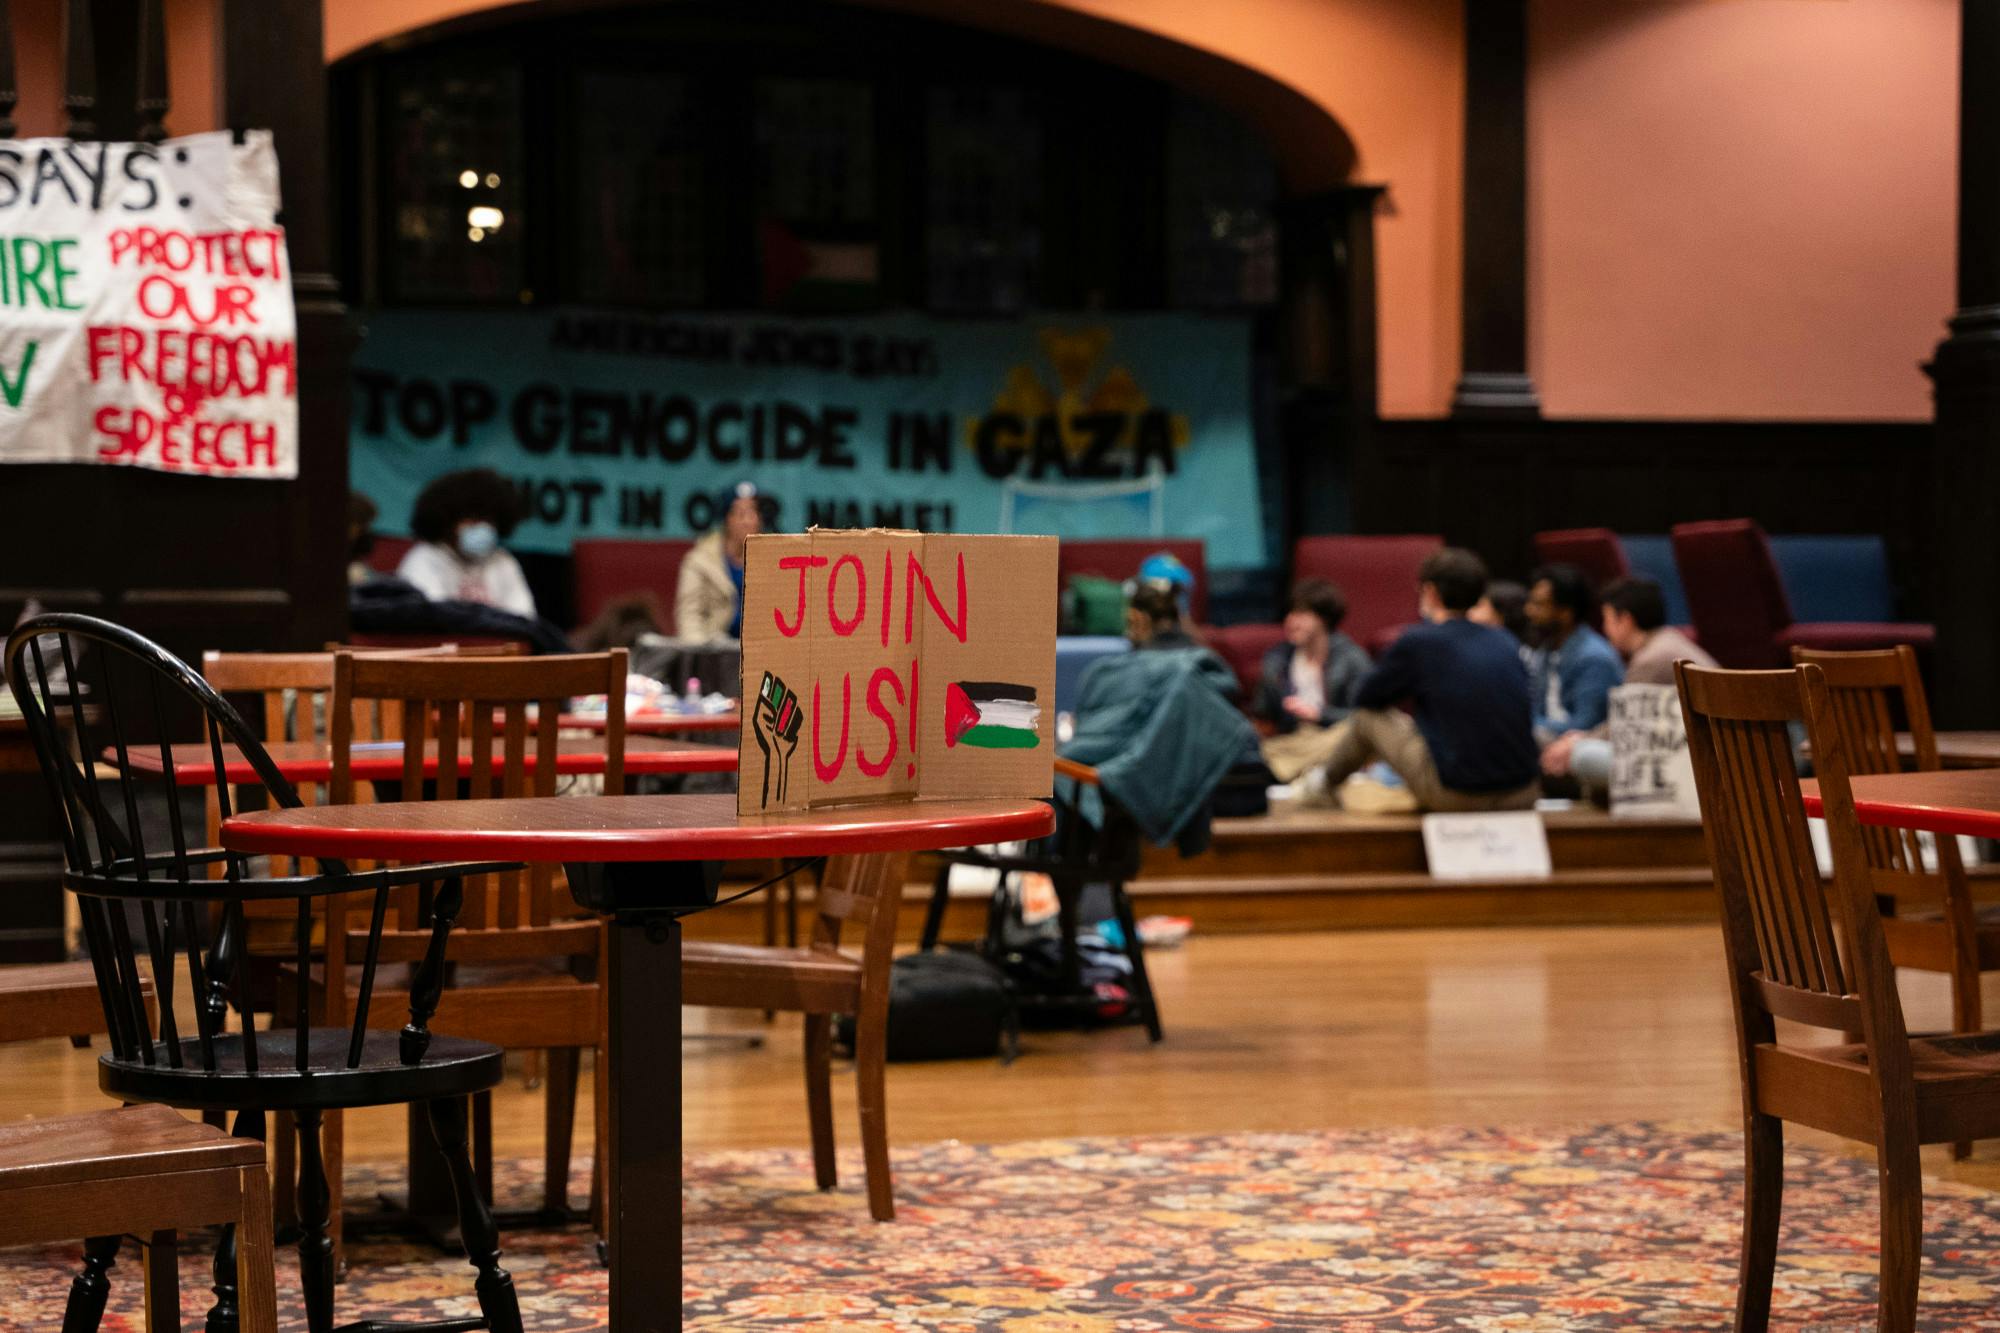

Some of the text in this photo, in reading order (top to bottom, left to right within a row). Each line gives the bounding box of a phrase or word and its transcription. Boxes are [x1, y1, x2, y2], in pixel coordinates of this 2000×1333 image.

[108, 227, 283, 281] PROTECT
[137, 274, 259, 327] OUR
[86, 326, 297, 397] FREEDOM
[95, 405, 277, 468] SPEECH
[513, 385, 855, 466] GENOCIDE
[887, 412, 951, 473] IN
[975, 405, 1177, 480] GAZA
[617, 485, 665, 530] IN
[686, 493, 781, 533] OR
[773, 547, 967, 648] JOIN
[812, 655, 919, 784] US!
